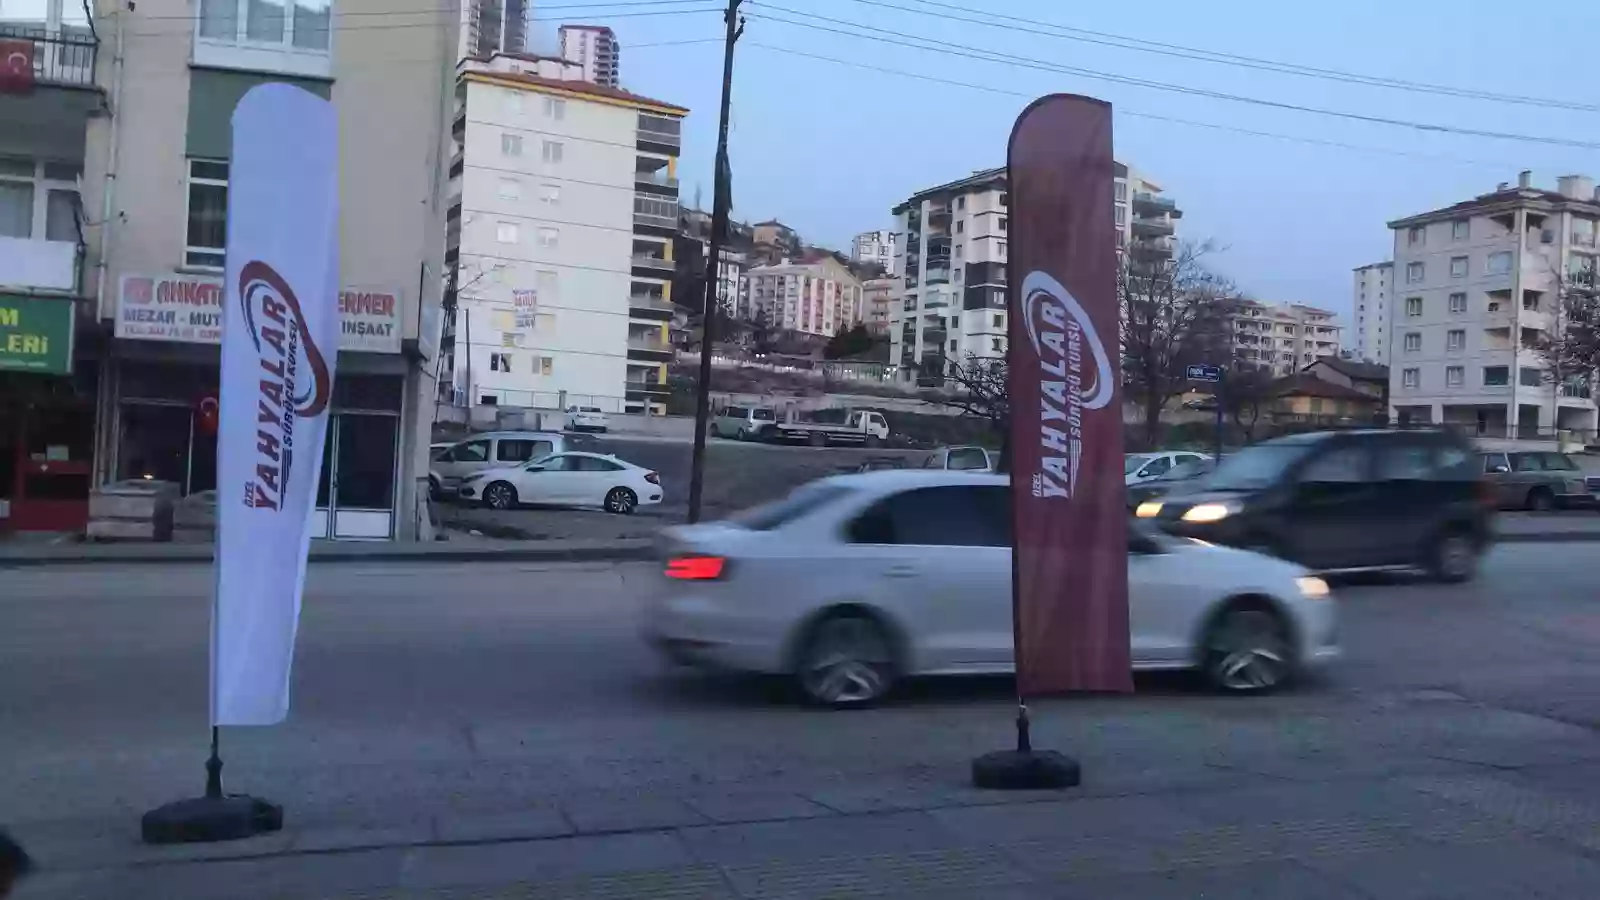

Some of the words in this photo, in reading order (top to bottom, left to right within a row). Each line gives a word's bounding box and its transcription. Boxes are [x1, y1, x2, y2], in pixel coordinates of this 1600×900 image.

[123, 308, 176, 325] MEZAR
[286, 319, 299, 377] KURSU
[1067, 320, 1081, 373] KURSU
[256, 294, 287, 512] YAHYALAR
[280, 377, 296, 447] SÜRÜCÜ
[1040, 301, 1069, 499] YAHYALAR
[1067, 375, 1081, 438] SÜRÜCÜ
